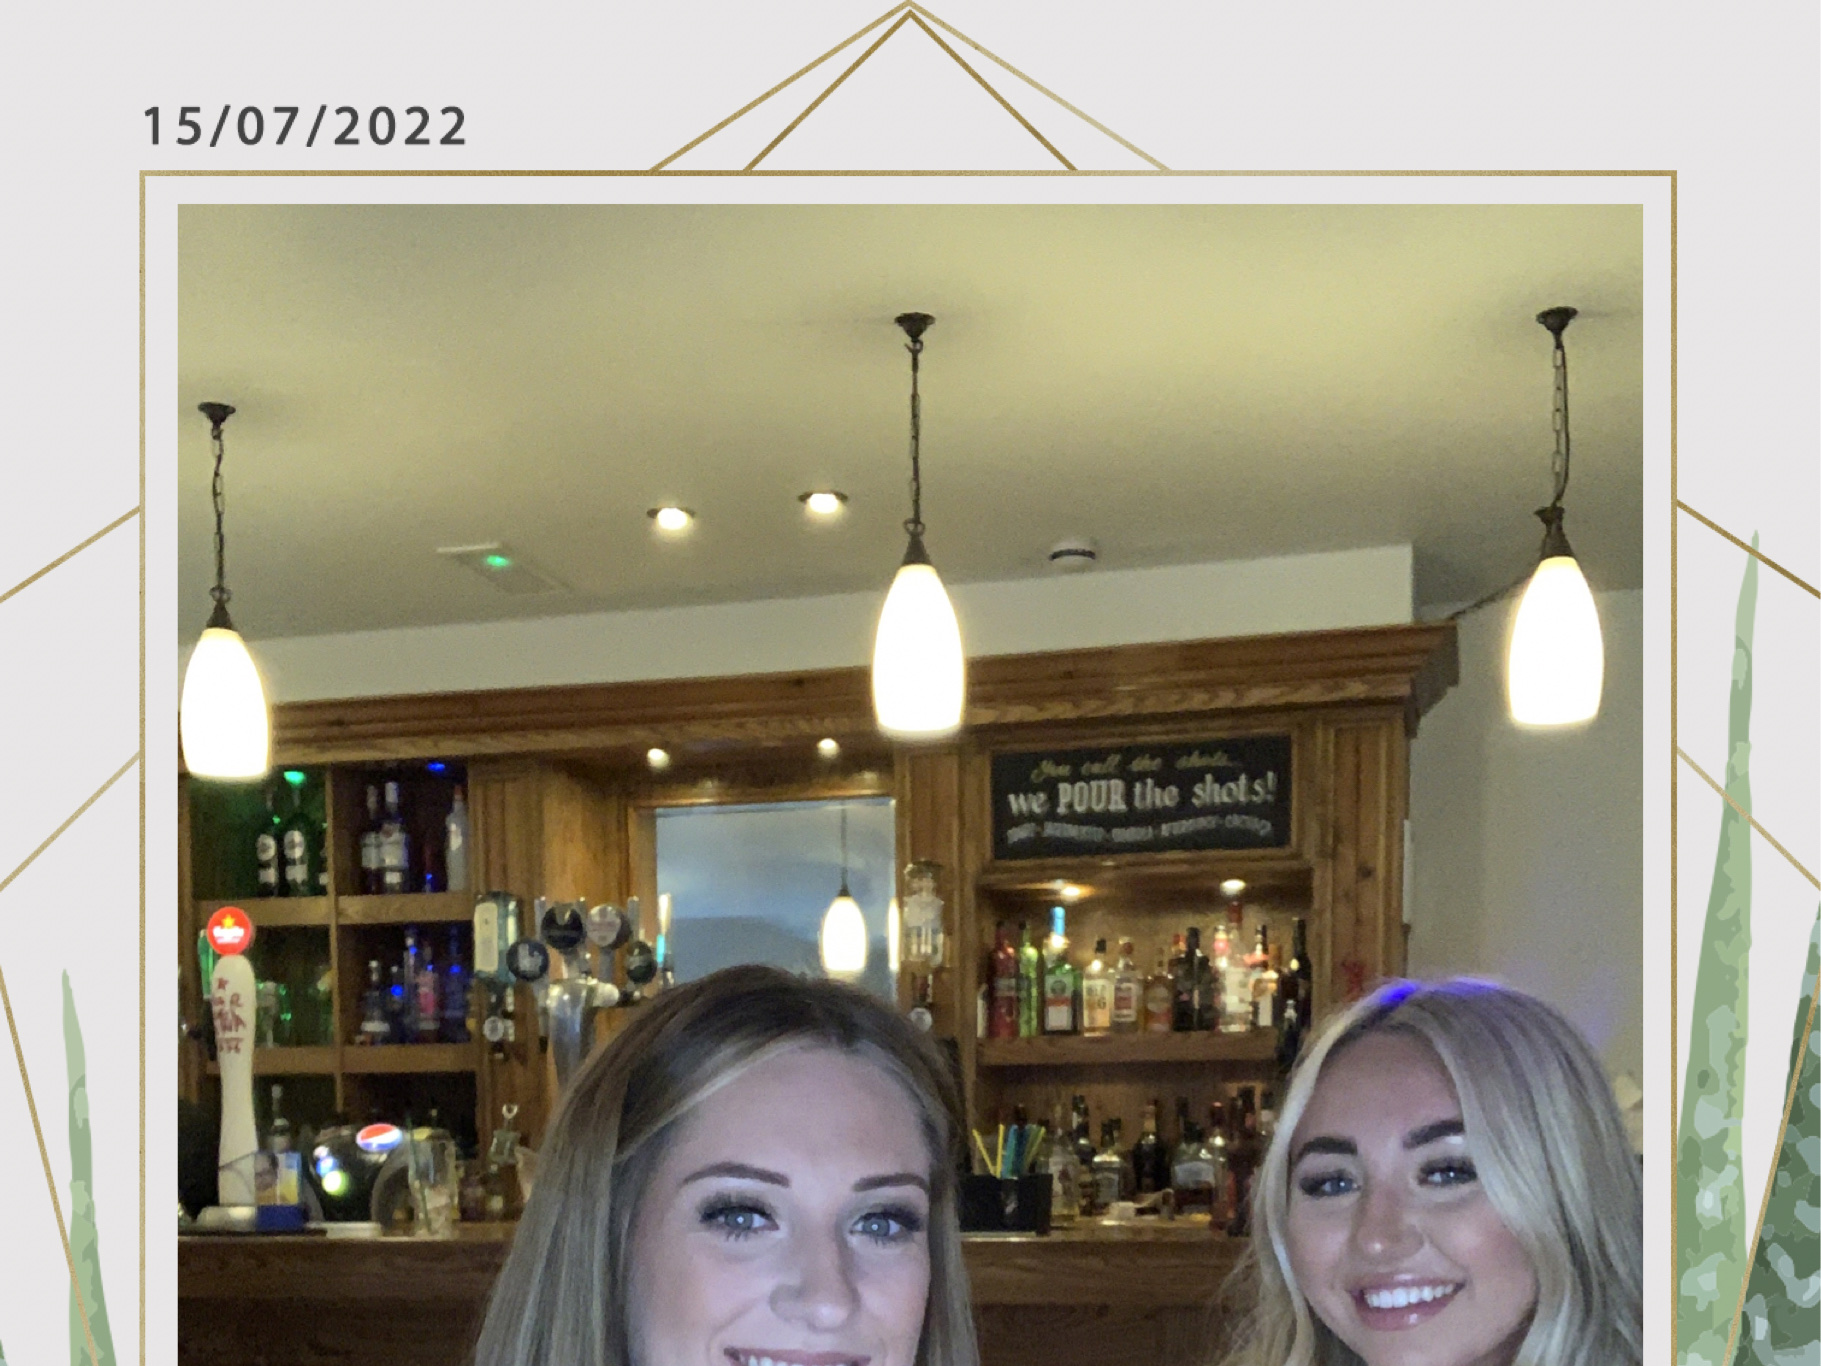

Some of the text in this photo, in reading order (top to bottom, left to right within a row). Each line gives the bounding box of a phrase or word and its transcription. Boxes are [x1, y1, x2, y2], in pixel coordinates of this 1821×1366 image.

[1007, 770, 1278, 815] we POUR the shots!
